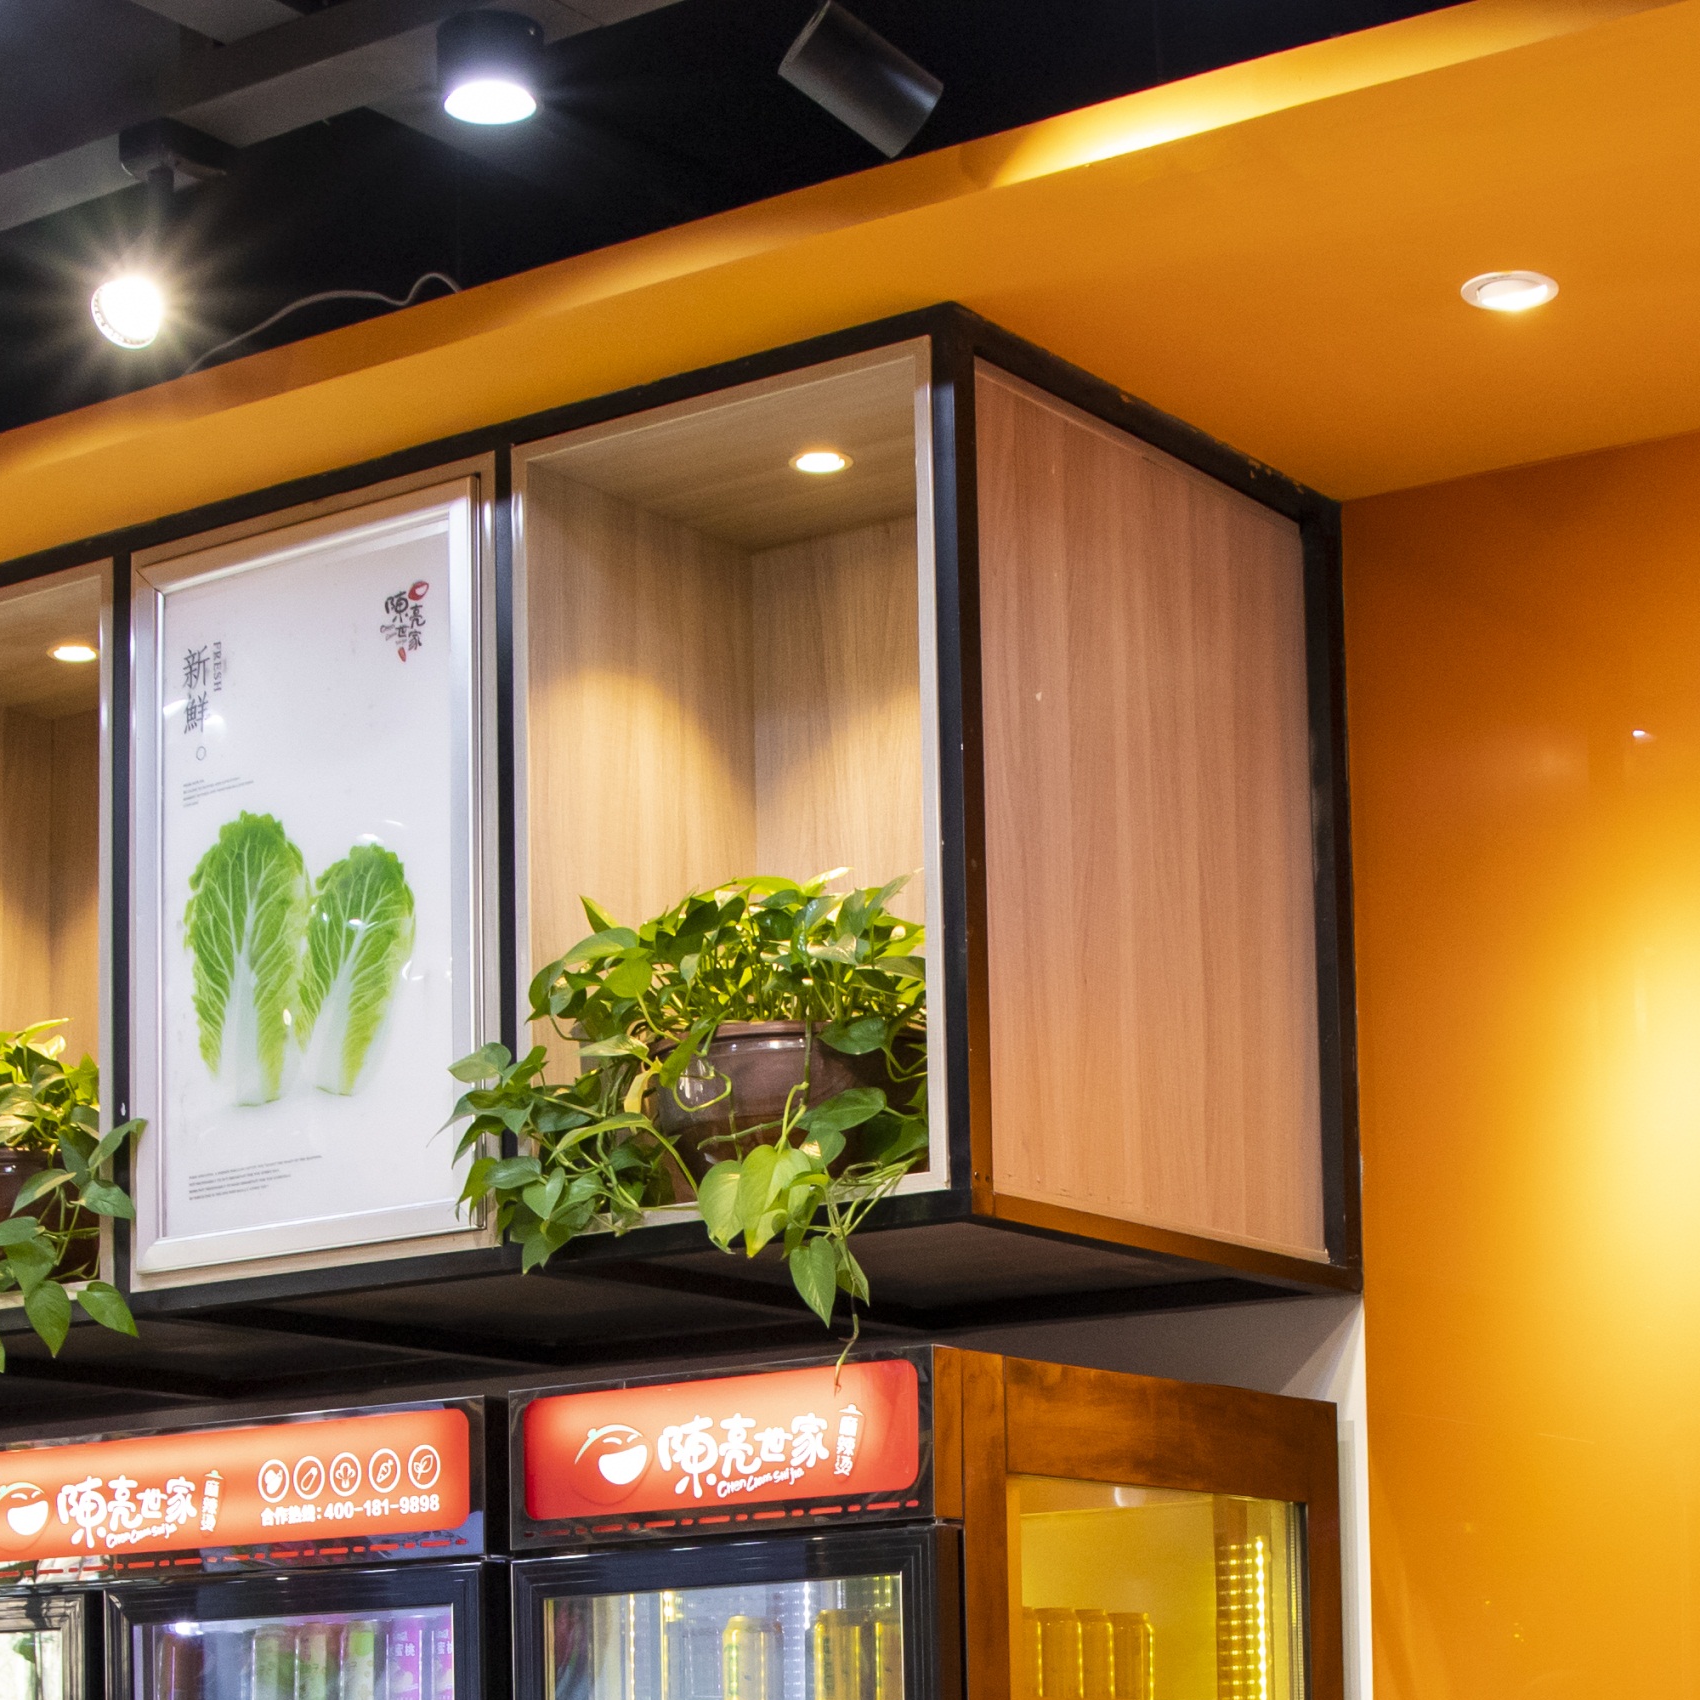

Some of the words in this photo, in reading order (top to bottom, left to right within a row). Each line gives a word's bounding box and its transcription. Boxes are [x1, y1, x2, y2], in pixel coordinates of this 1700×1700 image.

[213, 641, 222, 692] FRESH
[657, 1412, 830, 1499] 陳亮世家
[56, 1474, 198, 1549] 陳亮世家
